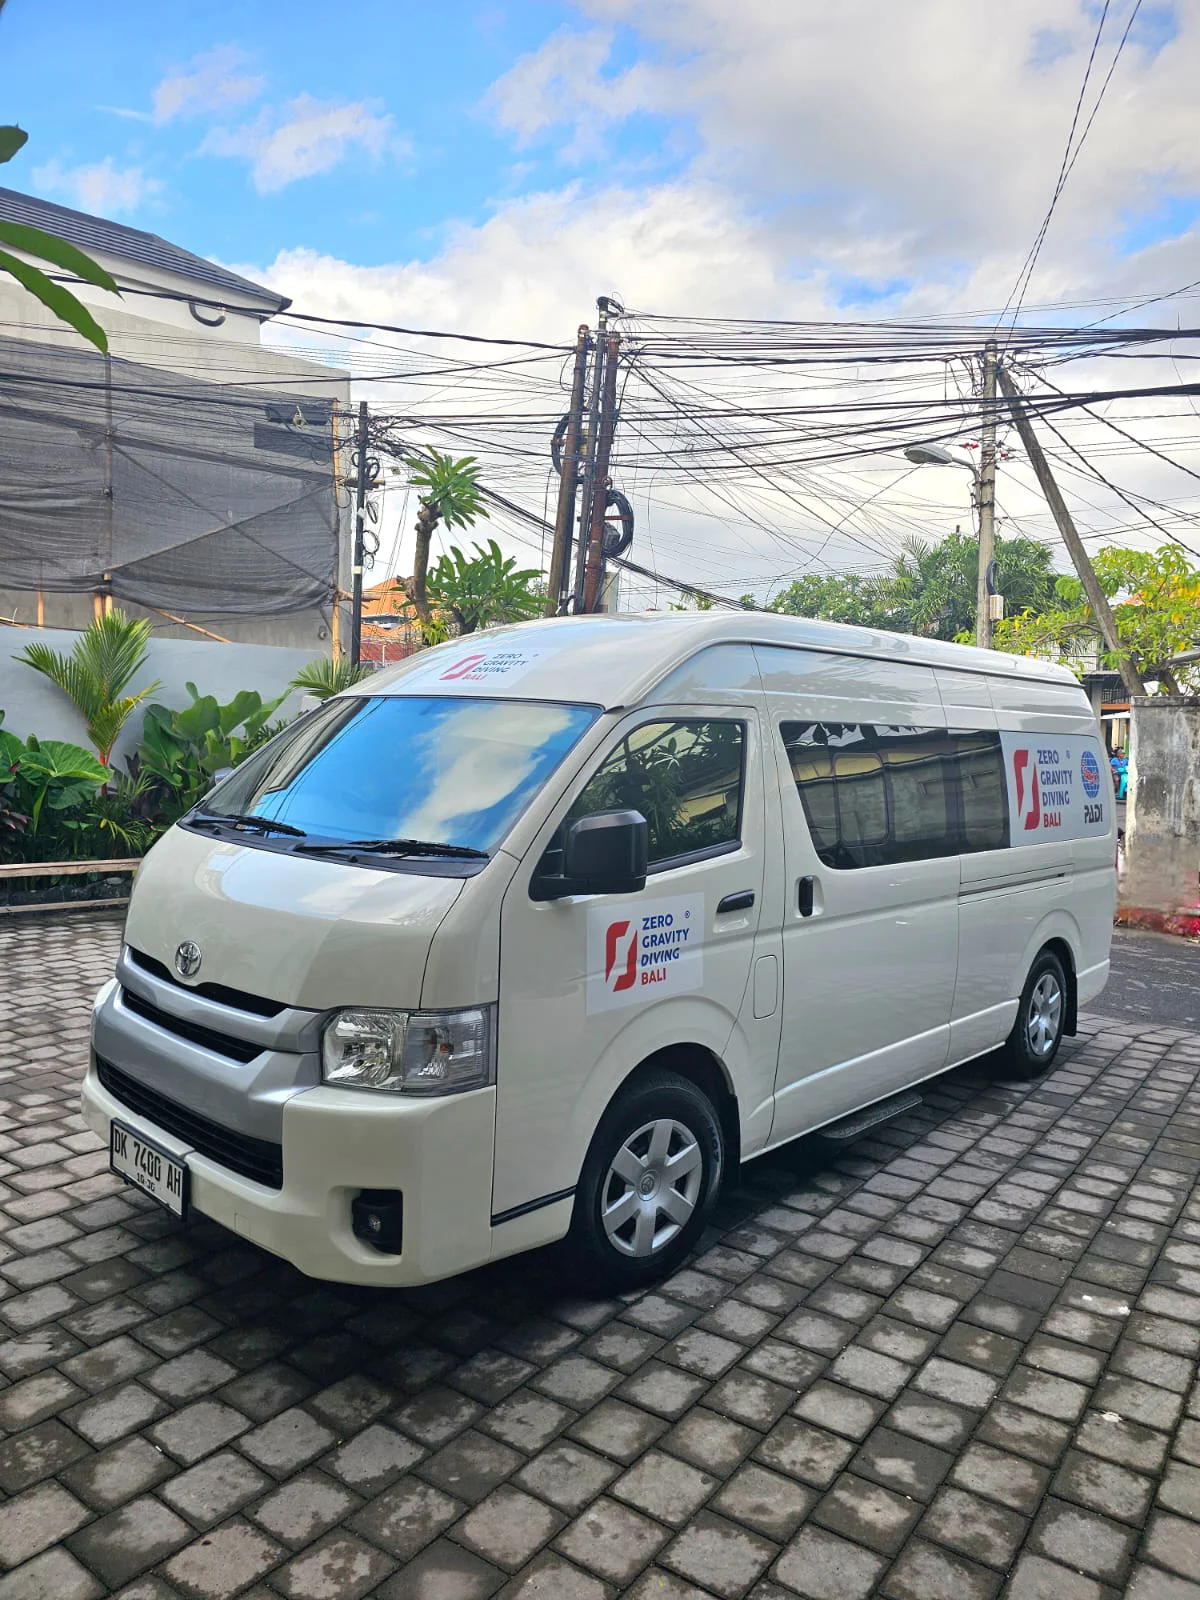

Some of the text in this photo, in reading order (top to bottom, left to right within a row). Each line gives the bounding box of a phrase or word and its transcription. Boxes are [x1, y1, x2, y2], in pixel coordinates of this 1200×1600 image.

[1037, 749, 1059, 764] ZERO
[1040, 770, 1072, 785] GRAVITY
[1042, 791, 1069, 806] DIVING
[1043, 812, 1061, 828] BALI
[1084, 804, 1103, 824] PADI
[642, 914, 673, 930] ZERO
[642, 928, 689, 948] GRAVITY
[641, 948, 680, 966] DIVING
[641, 968, 666, 985] BALI
[114, 1128, 127, 1159] DK
[167, 1163, 181, 1197] AH
